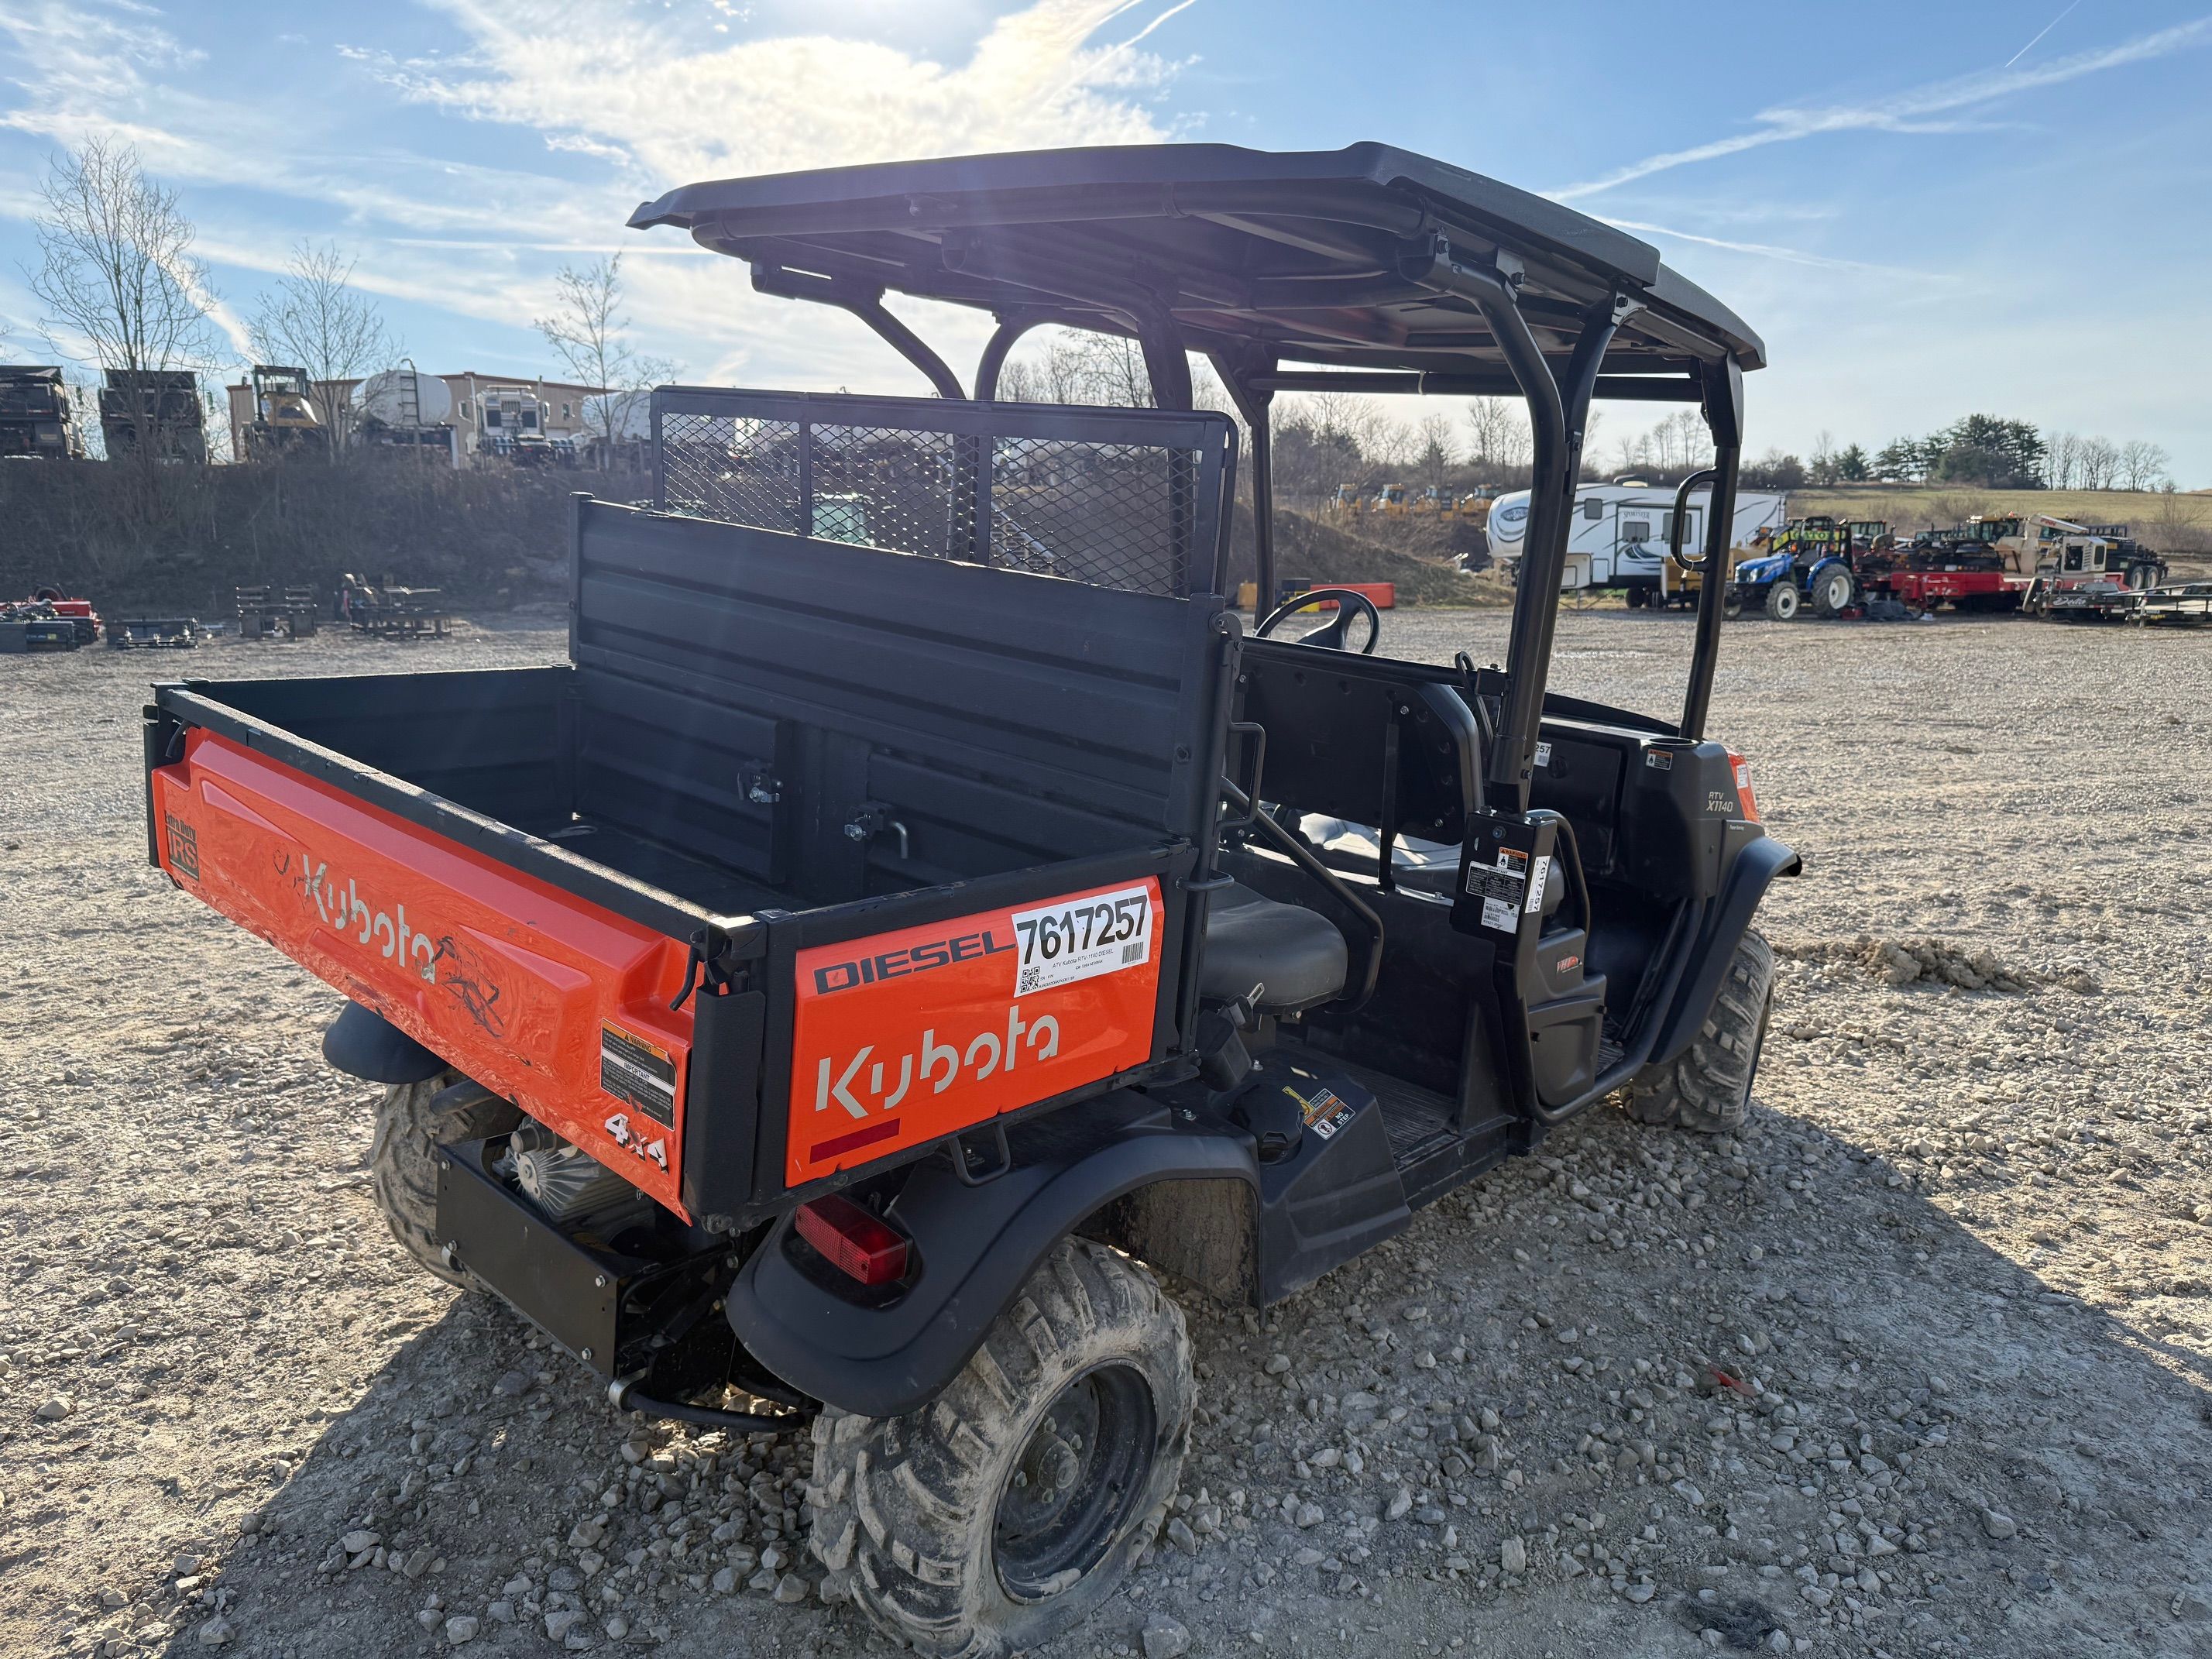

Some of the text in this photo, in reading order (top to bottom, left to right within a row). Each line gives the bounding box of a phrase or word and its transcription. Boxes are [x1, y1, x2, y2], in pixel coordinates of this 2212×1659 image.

[1706, 800, 1733, 812] X1140
[1708, 792, 1724, 800] RTV
[1534, 859, 1548, 911] 7617257
[303, 854, 435, 984] Kubota
[1016, 895, 1148, 965] 7617257
[814, 931, 1017, 994] DIESEL
[630, 1034, 651, 1053] WARNING
[623, 1062, 650, 1081] IMPORTANT
[816, 1005, 1060, 1119] Kubota
[1337, 1113, 1349, 1125] STEP
